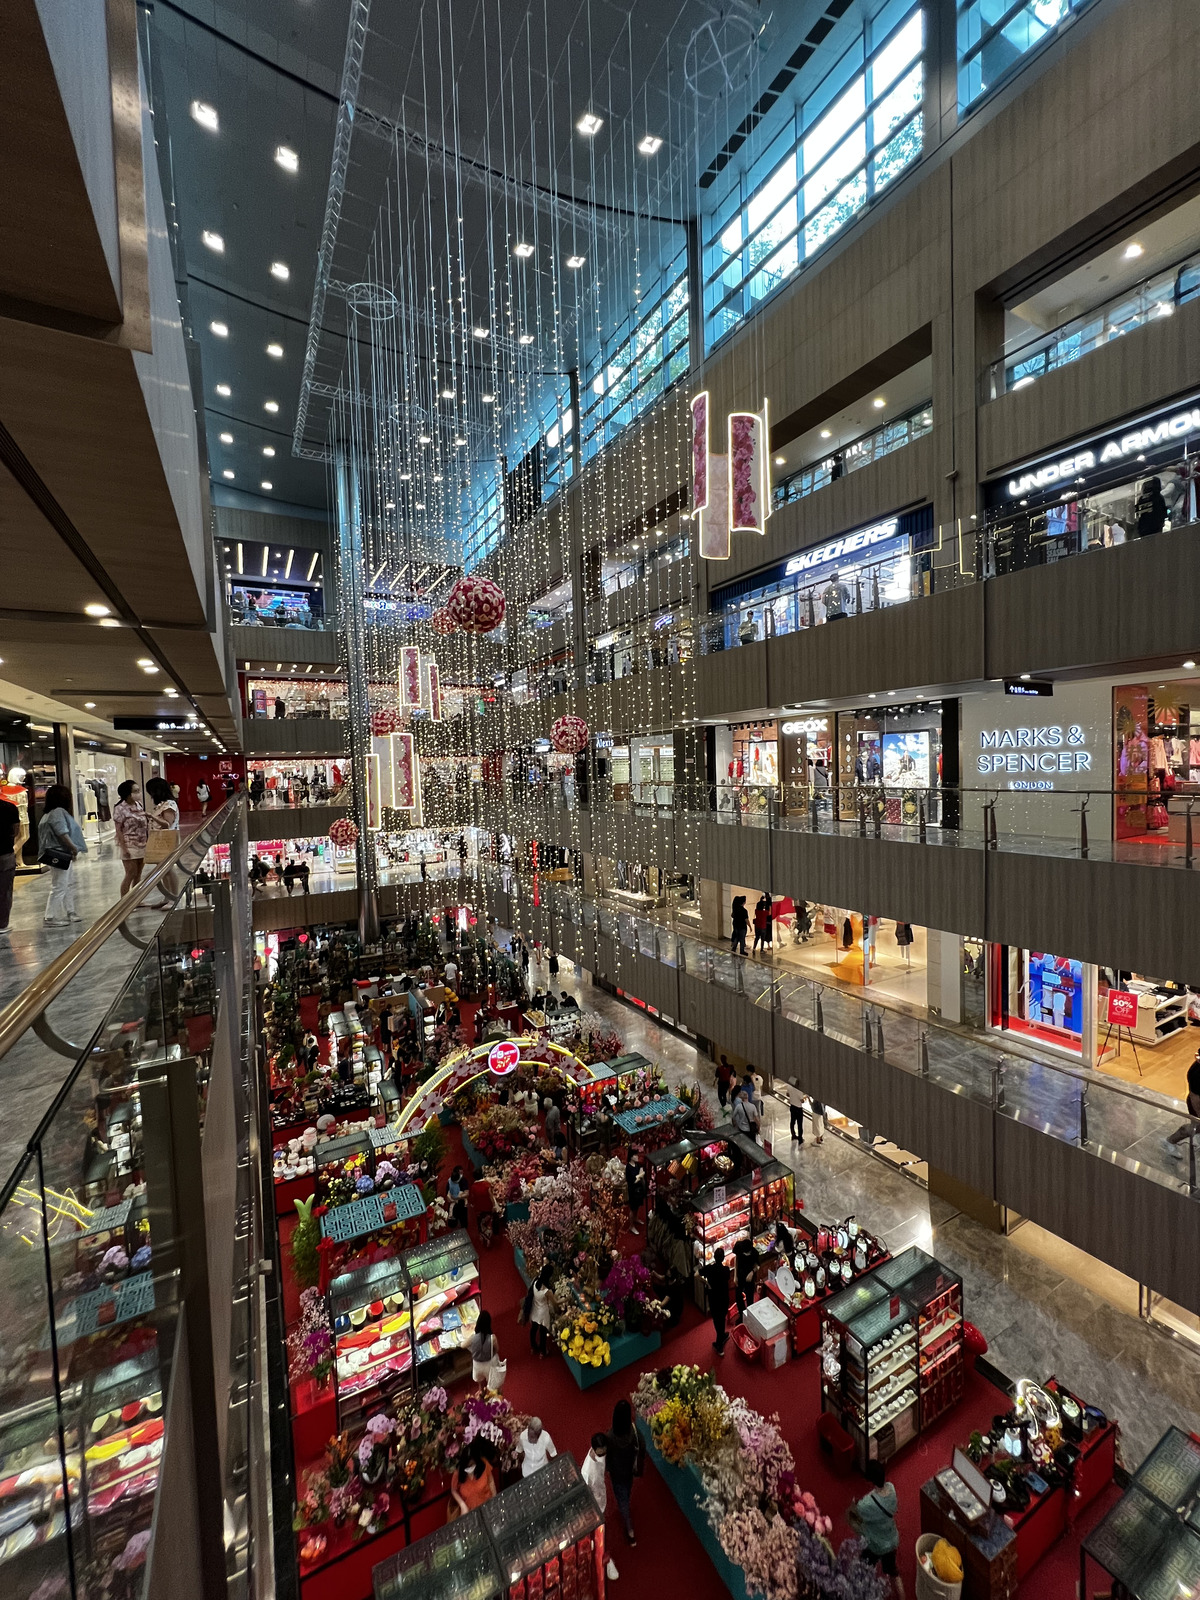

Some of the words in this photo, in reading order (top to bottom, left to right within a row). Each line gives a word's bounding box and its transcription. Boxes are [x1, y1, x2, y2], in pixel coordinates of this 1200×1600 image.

[1009, 451, 1095, 496] UNDER
[785, 518, 898, 576] SKECHERS
[781, 719, 829, 735] GEOX
[980, 726, 1062, 748] MARKS
[1066, 725, 1085, 745] &
[976, 751, 1092, 774] SPENCER
[1008, 780, 1054, 790] LONDON
[1112, 998, 1134, 1009] 50%
[1114, 1006, 1130, 1014] OFF
